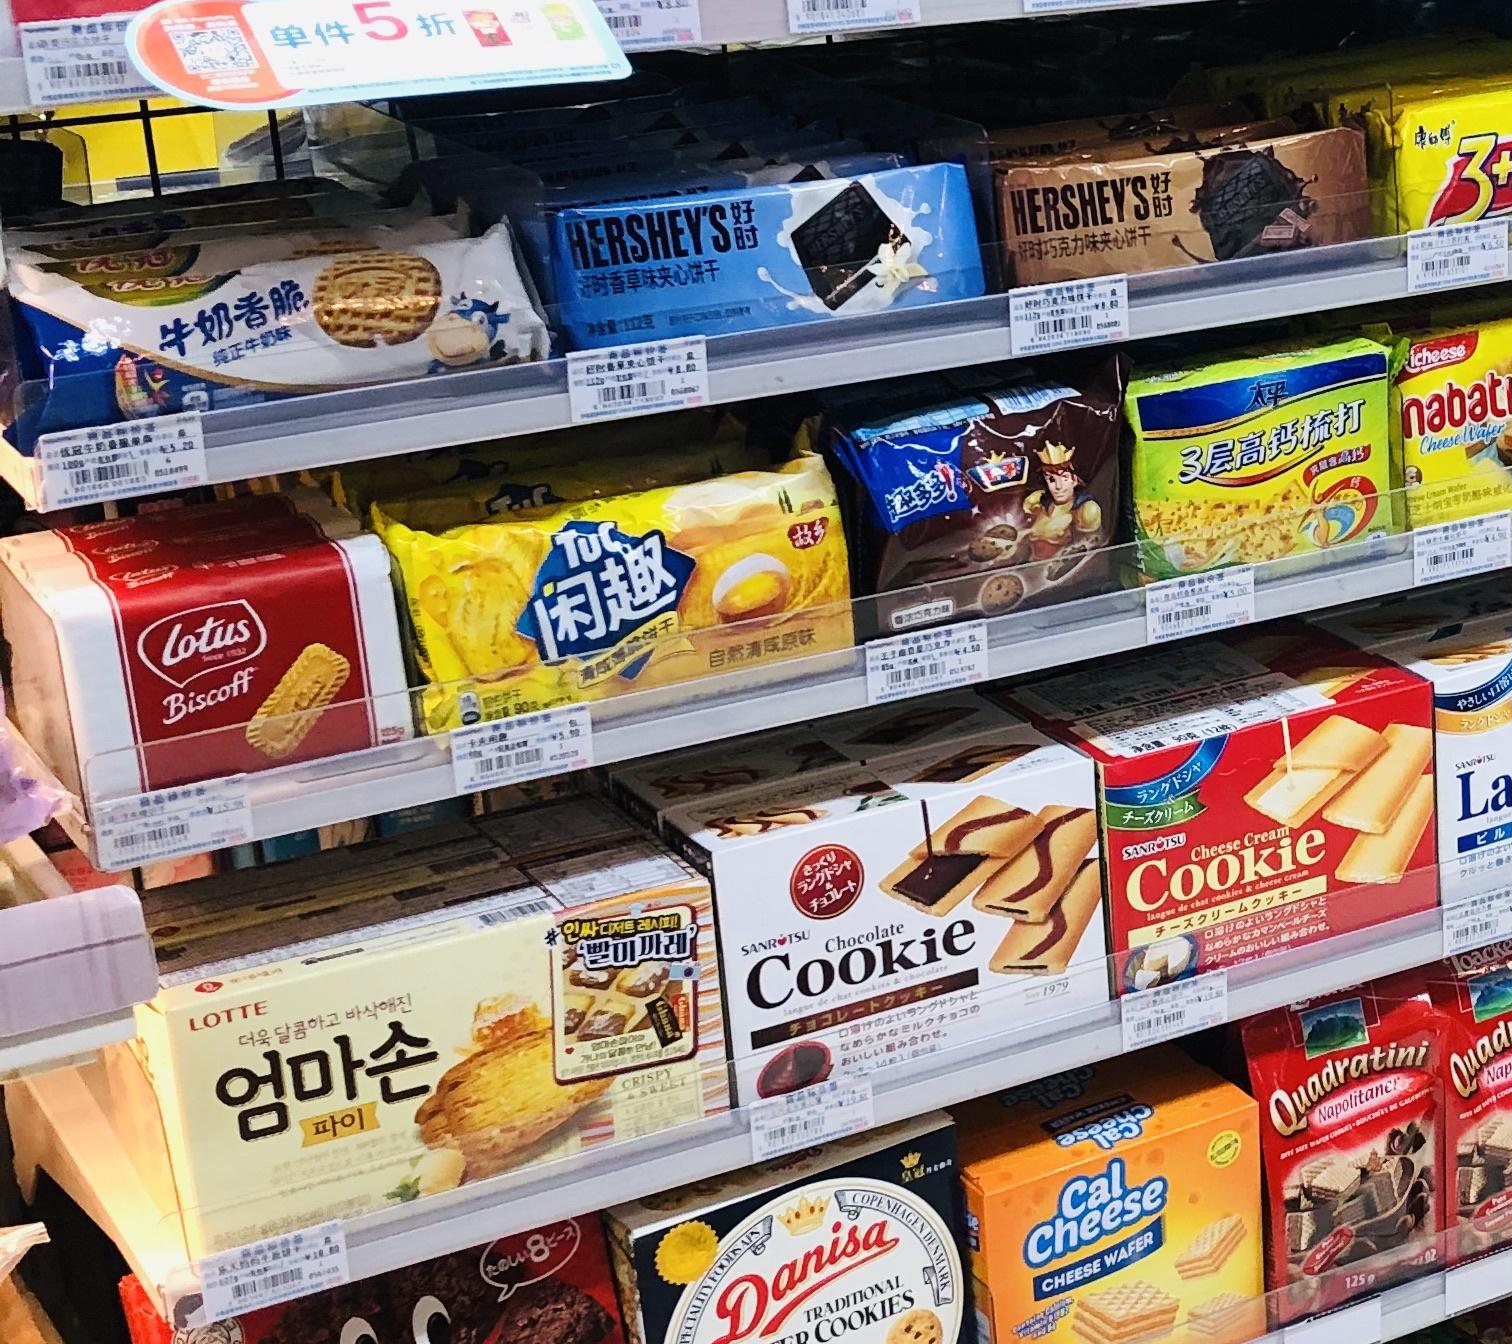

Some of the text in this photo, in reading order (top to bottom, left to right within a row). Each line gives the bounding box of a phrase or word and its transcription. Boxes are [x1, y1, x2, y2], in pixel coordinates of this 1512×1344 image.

[1011, 175, 1150, 236] HERSHEY'S
[566, 202, 728, 271] HERSHEY'S
[157, 283, 311, 353] 牛奶香脆
[212, 328, 293, 366] 纯正牛奶味
[1247, 381, 1288, 407] 太平
[1177, 399, 1367, 486] 3层高钙梳打
[538, 531, 677, 666] 闲趣
[162, 619, 251, 667] Lotus
[709, 626, 817, 669] 自然清咸原味
[162, 662, 258, 726] Biscoff
[1122, 799, 1195, 825] チーズクリーム
[1126, 828, 1326, 913] Cookie
[1190, 825, 1290, 862] Cheese Cream
[746, 918, 976, 1010] Cookie
[825, 922, 905, 954] Chocolate
[189, 1001, 270, 1034] LOTTE
[239, 994, 414, 1050] 더욱 달콤하고 바삭해진
[216, 1021, 441, 1143] 엄마손
[1268, 1040, 1431, 1140] Quadratini
[1316, 1079, 1402, 1124] Napolitaner
[312, 1110, 366, 1138] 파이
[1059, 1157, 1126, 1217] Cal
[1024, 1177, 1167, 1267] Cheese
[1041, 1233, 1155, 1295] CHEESE WAFER
[803, 1275, 903, 1323] TRADITIONAL
